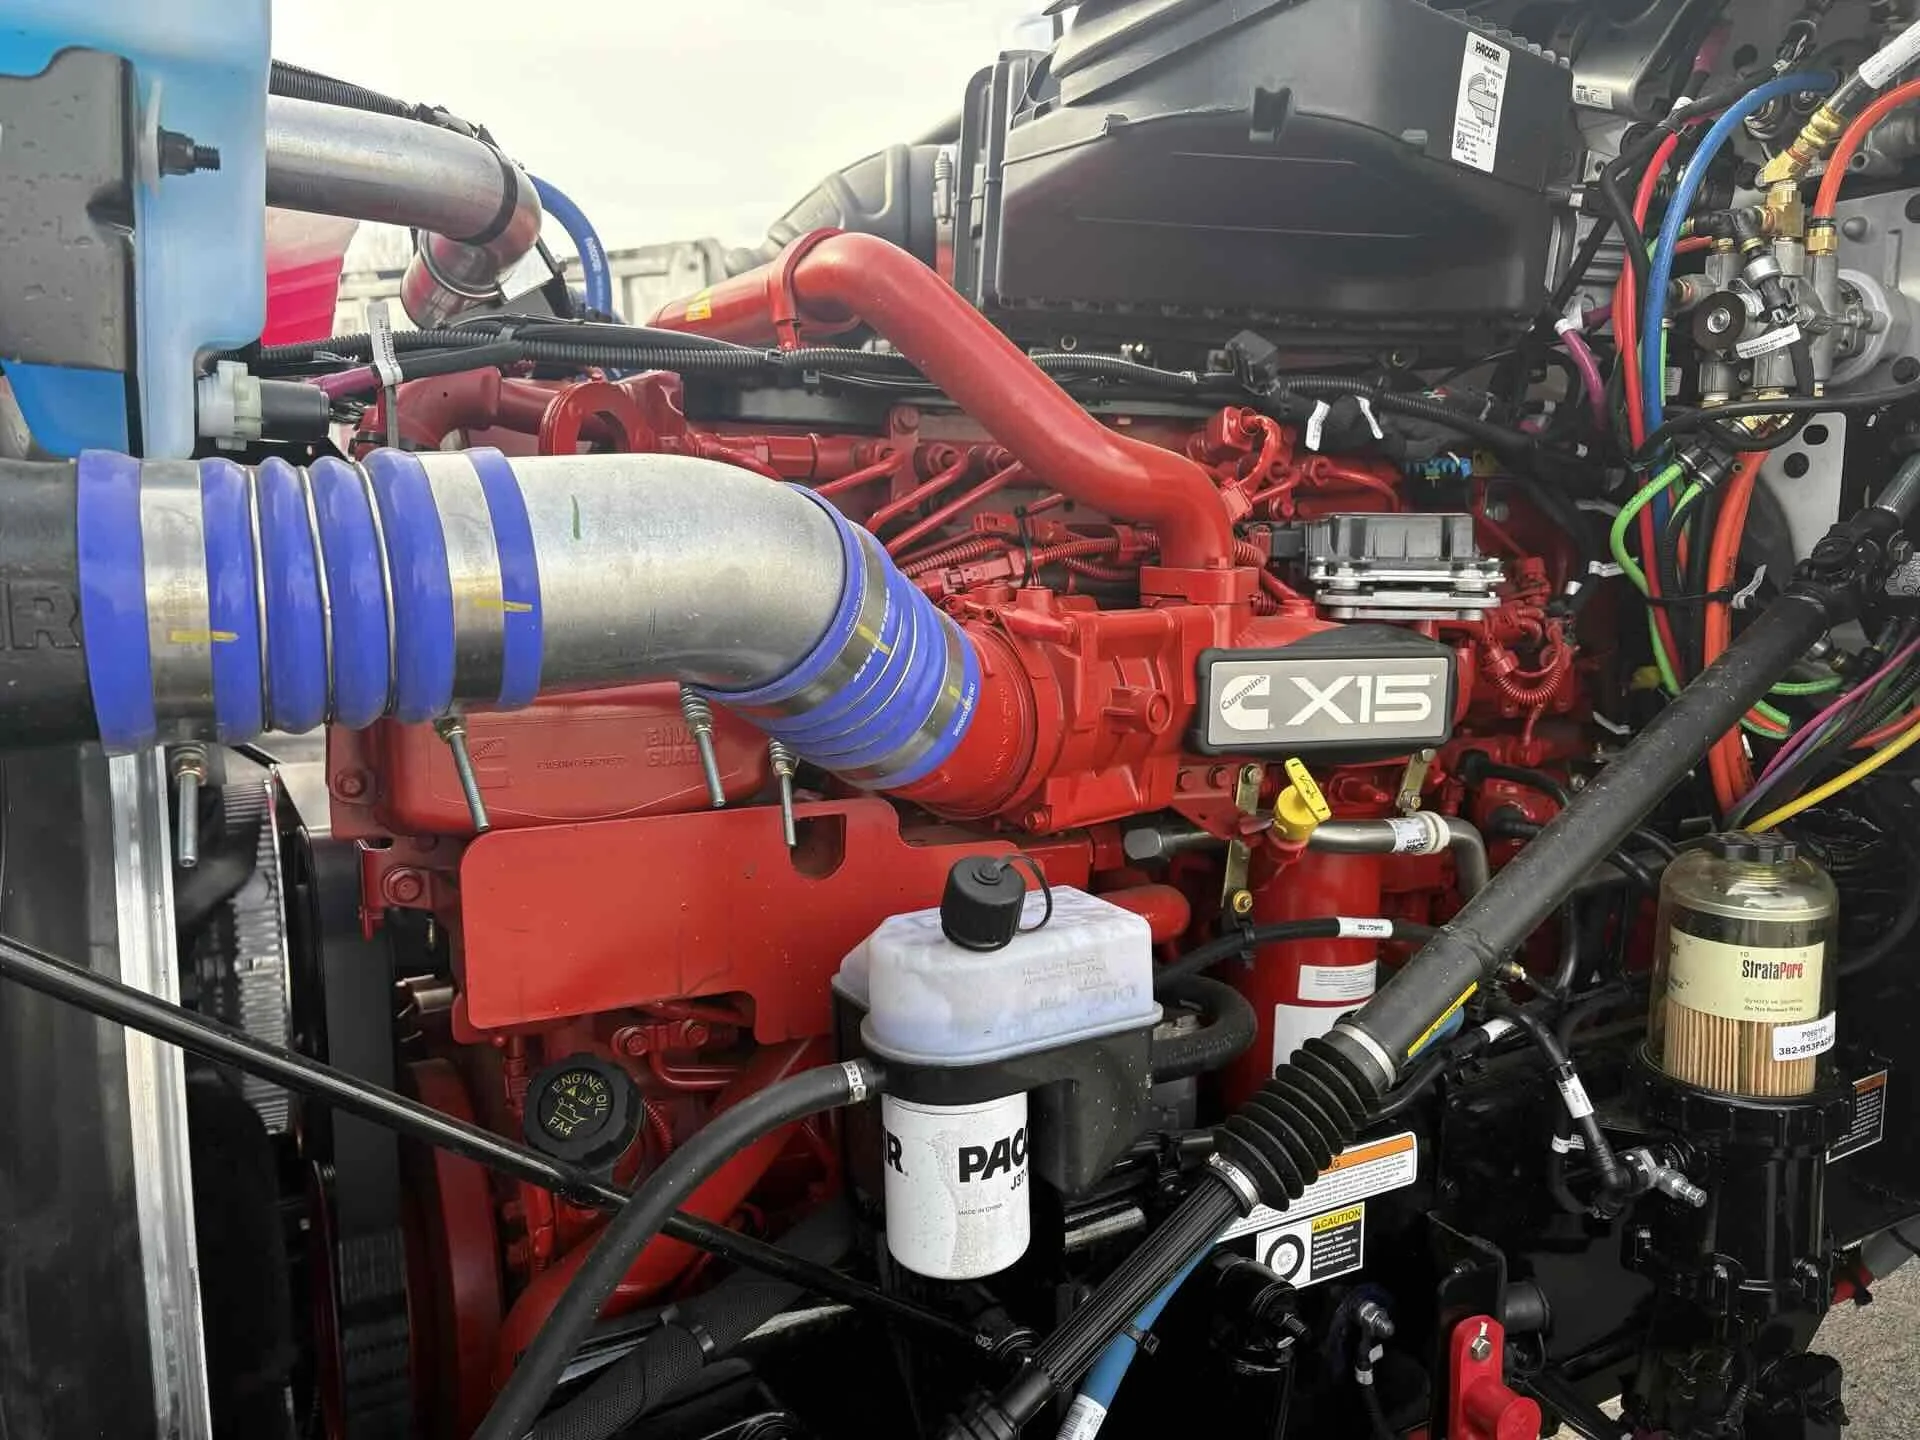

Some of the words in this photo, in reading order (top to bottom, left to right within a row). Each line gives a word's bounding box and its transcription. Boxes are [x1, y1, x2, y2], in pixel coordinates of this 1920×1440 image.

[1221, 675, 1267, 711] Cummins
[1285, 674, 1433, 726] X15
[1742, 959, 1804, 980] StrataPore
[551, 1073, 604, 1094] ENGINE
[596, 1094, 608, 1116] OIL
[547, 1116, 574, 1136] FA4
[1320, 1208, 1362, 1229] CAUTION
